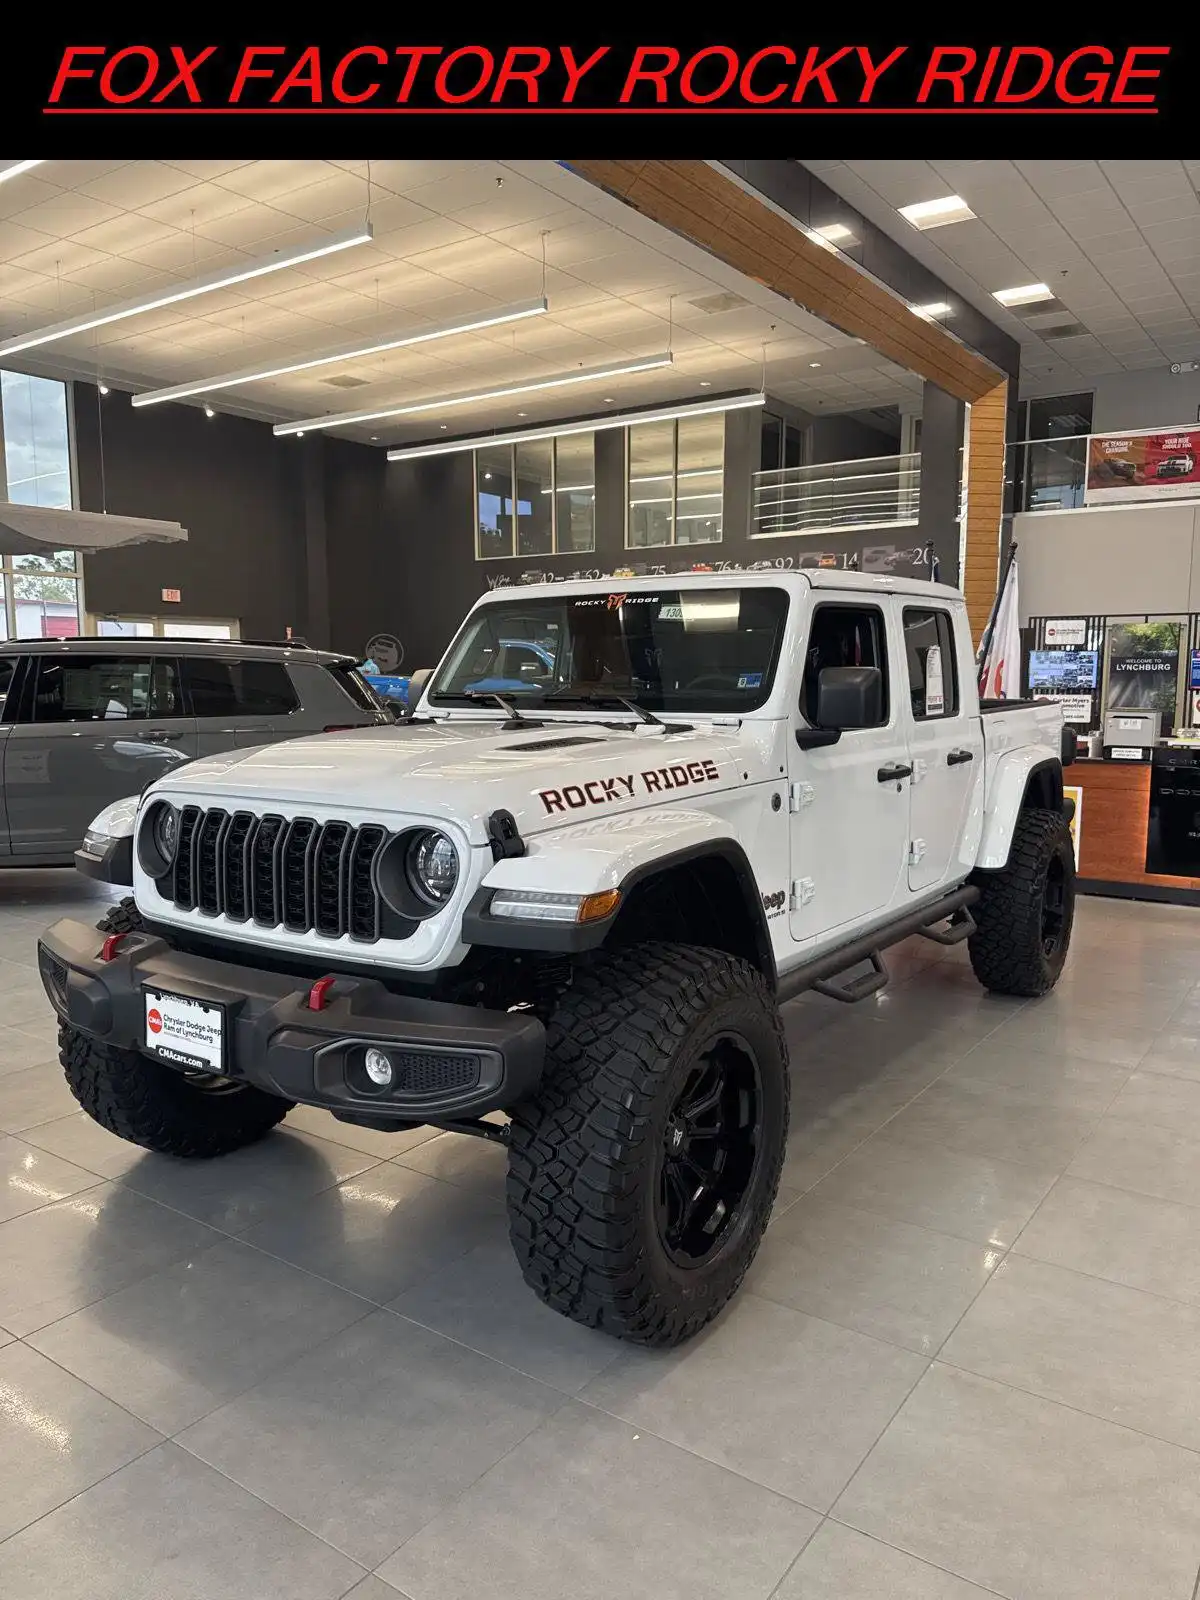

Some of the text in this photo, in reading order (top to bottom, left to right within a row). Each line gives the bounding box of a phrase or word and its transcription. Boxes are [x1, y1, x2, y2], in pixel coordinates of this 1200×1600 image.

[715, 560, 731, 572] 76
[775, 557, 794, 570] 92
[842, 552, 859, 570] 14
[650, 565, 667, 576] 75
[539, 572, 554, 584] 42
[665, 607, 683, 618] 130
[1116, 663, 1171, 671] LYNCHBURG
[539, 759, 720, 815] ROCKY RIDGE
[163, 1014, 222, 1036] Chrysler Dodge Jeep
[163, 1022, 175, 1032] Ram
[175, 1026, 182, 1034] of
[182, 1028, 214, 1044] Lynchburg
[158, 1047, 203, 1069] CMAcars.com
